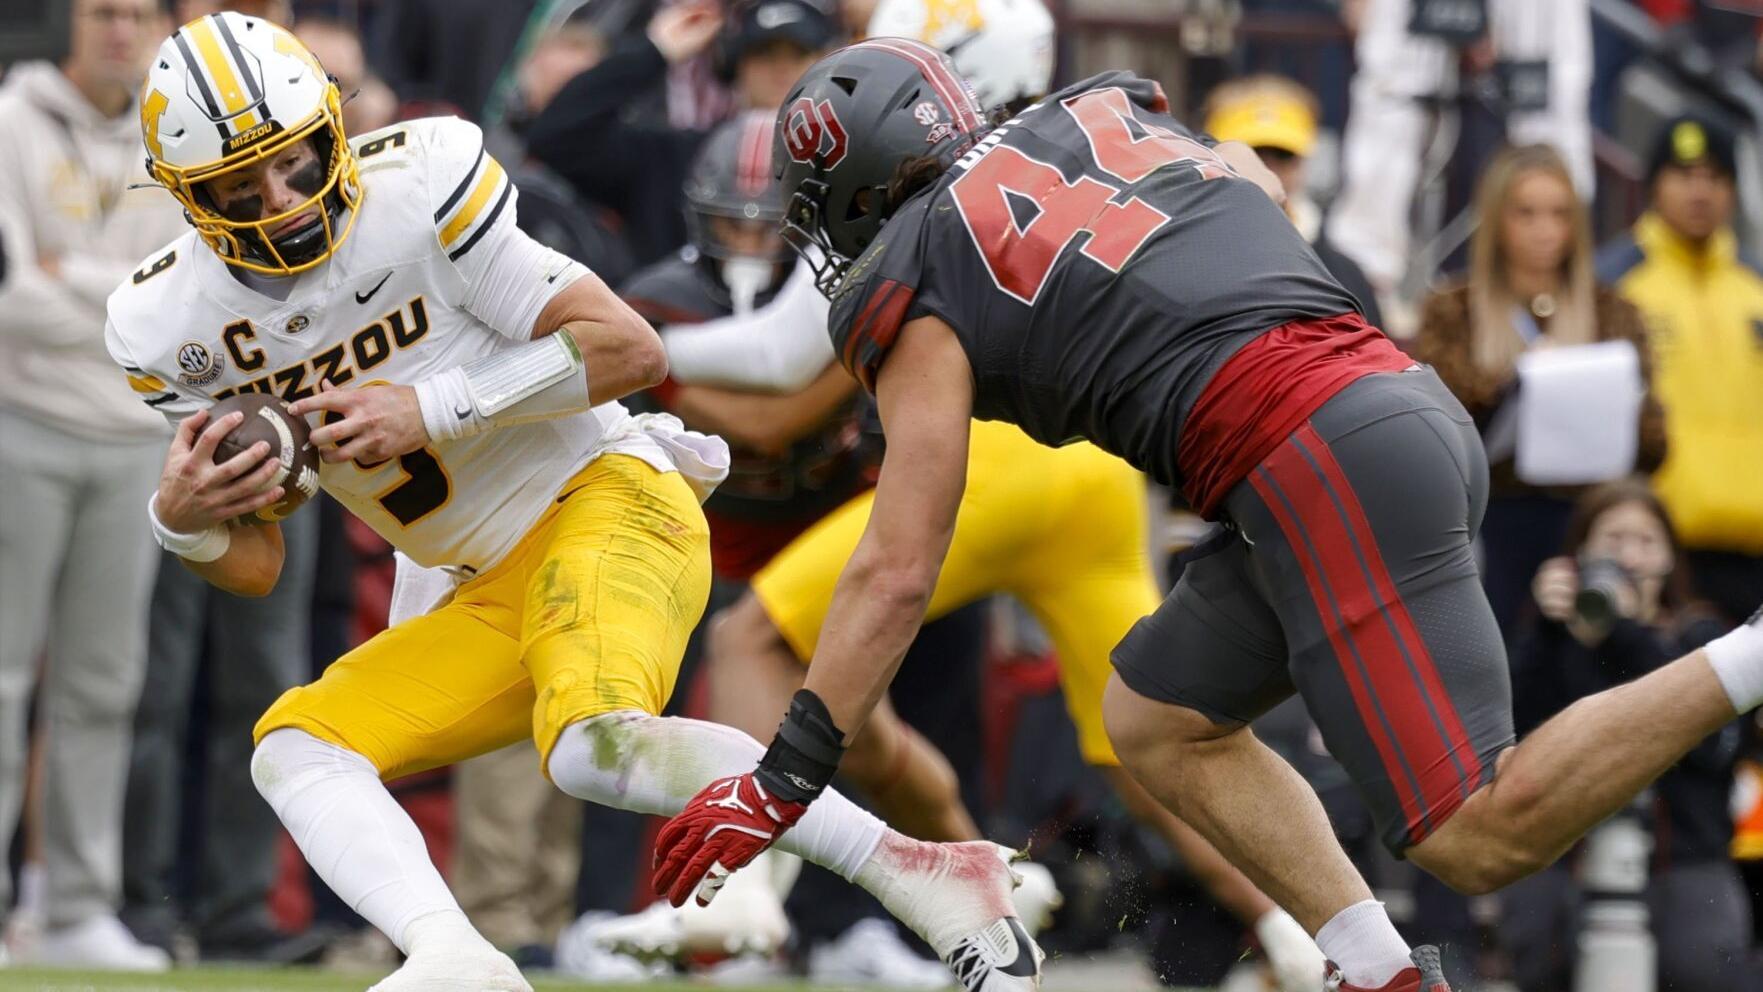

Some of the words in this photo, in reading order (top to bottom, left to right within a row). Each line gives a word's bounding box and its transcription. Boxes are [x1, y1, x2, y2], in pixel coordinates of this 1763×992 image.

[229, 122, 273, 150] MIZZOU
[358, 130, 408, 159] 9
[949, 86, 1241, 306] 44
[132, 249, 177, 285] 9
[222, 318, 268, 374] C
[185, 360, 225, 387] GRADUATE
